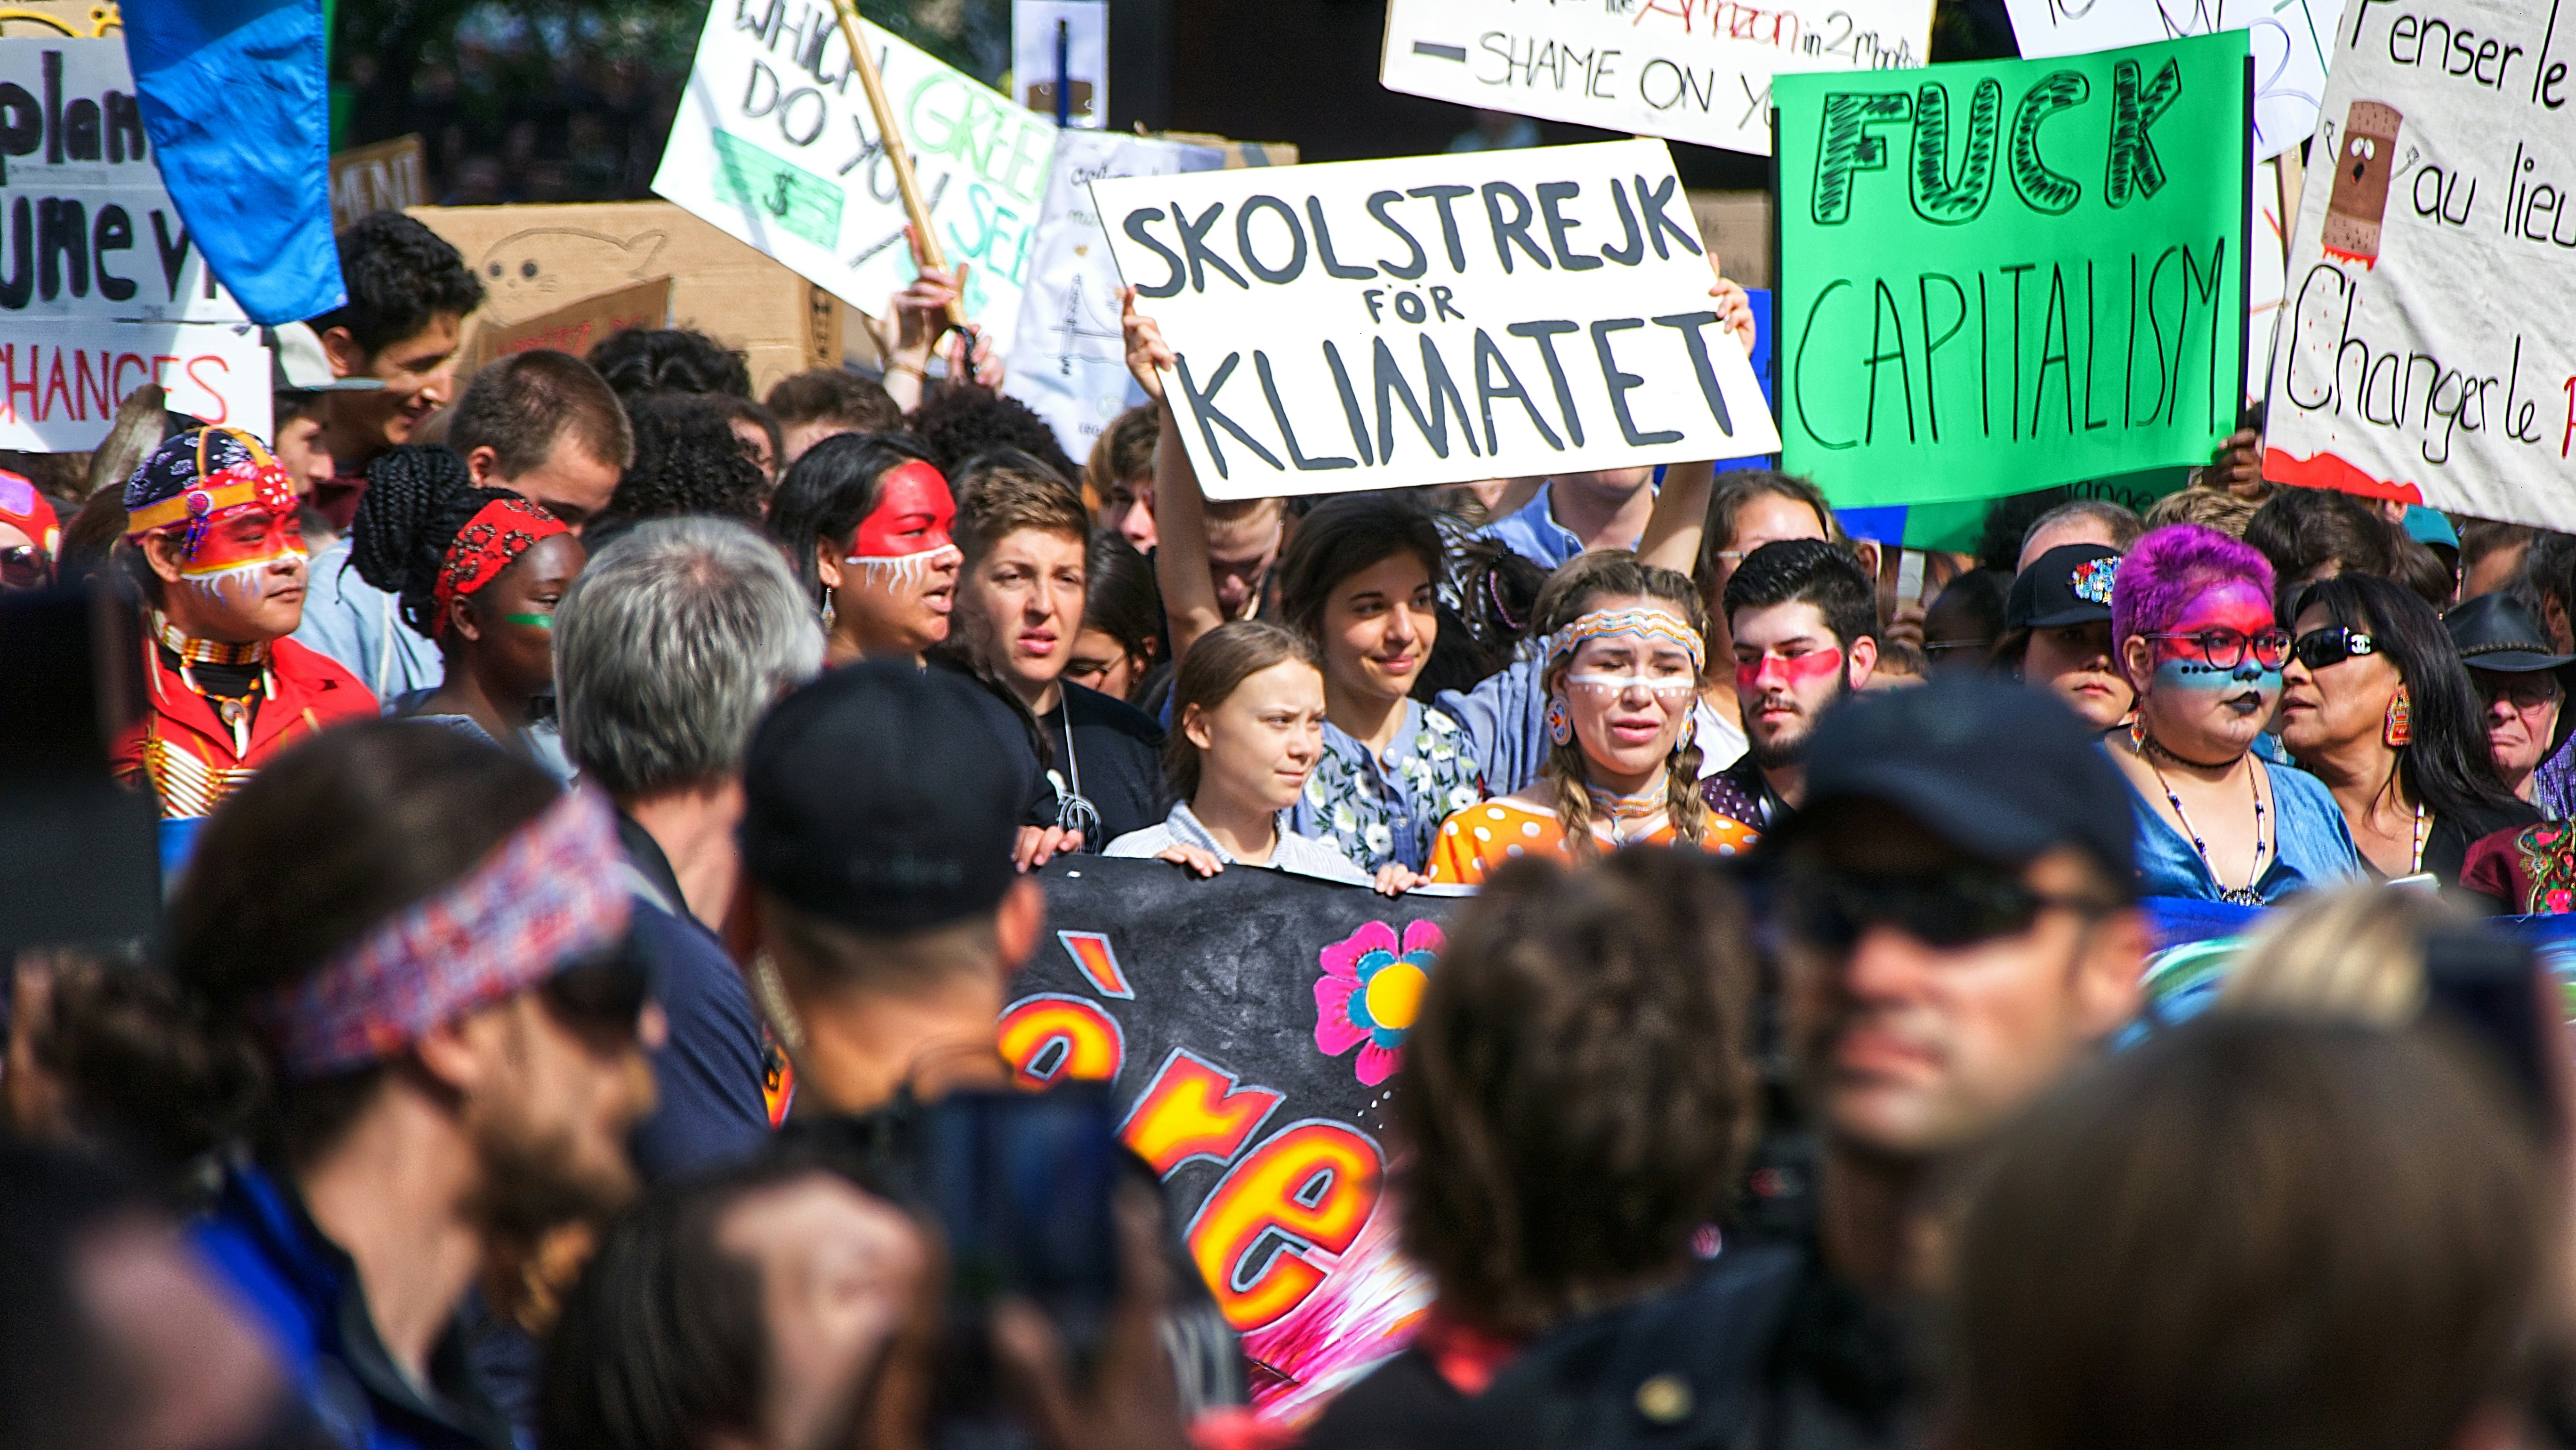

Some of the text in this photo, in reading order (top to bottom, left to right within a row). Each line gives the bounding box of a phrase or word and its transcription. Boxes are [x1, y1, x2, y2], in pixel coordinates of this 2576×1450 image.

[1476, 31, 1772, 130] SHAME ON Y
[1824, 9, 1853, 56] 2
[2532, 0, 2568, 110] le
[742, 58, 826, 147] DO
[1811, 56, 2182, 226] FUCK
[1124, 174, 1702, 298] SKOLSTREJK
[2413, 139, 2576, 249] au lieu
[1363, 284, 1464, 323] FÖR
[1795, 235, 2224, 450] CAPITALISM
[1174, 311, 1733, 479] KLIMATET
[2287, 263, 2498, 465] Changer
[2505, 333, 2542, 444] le
